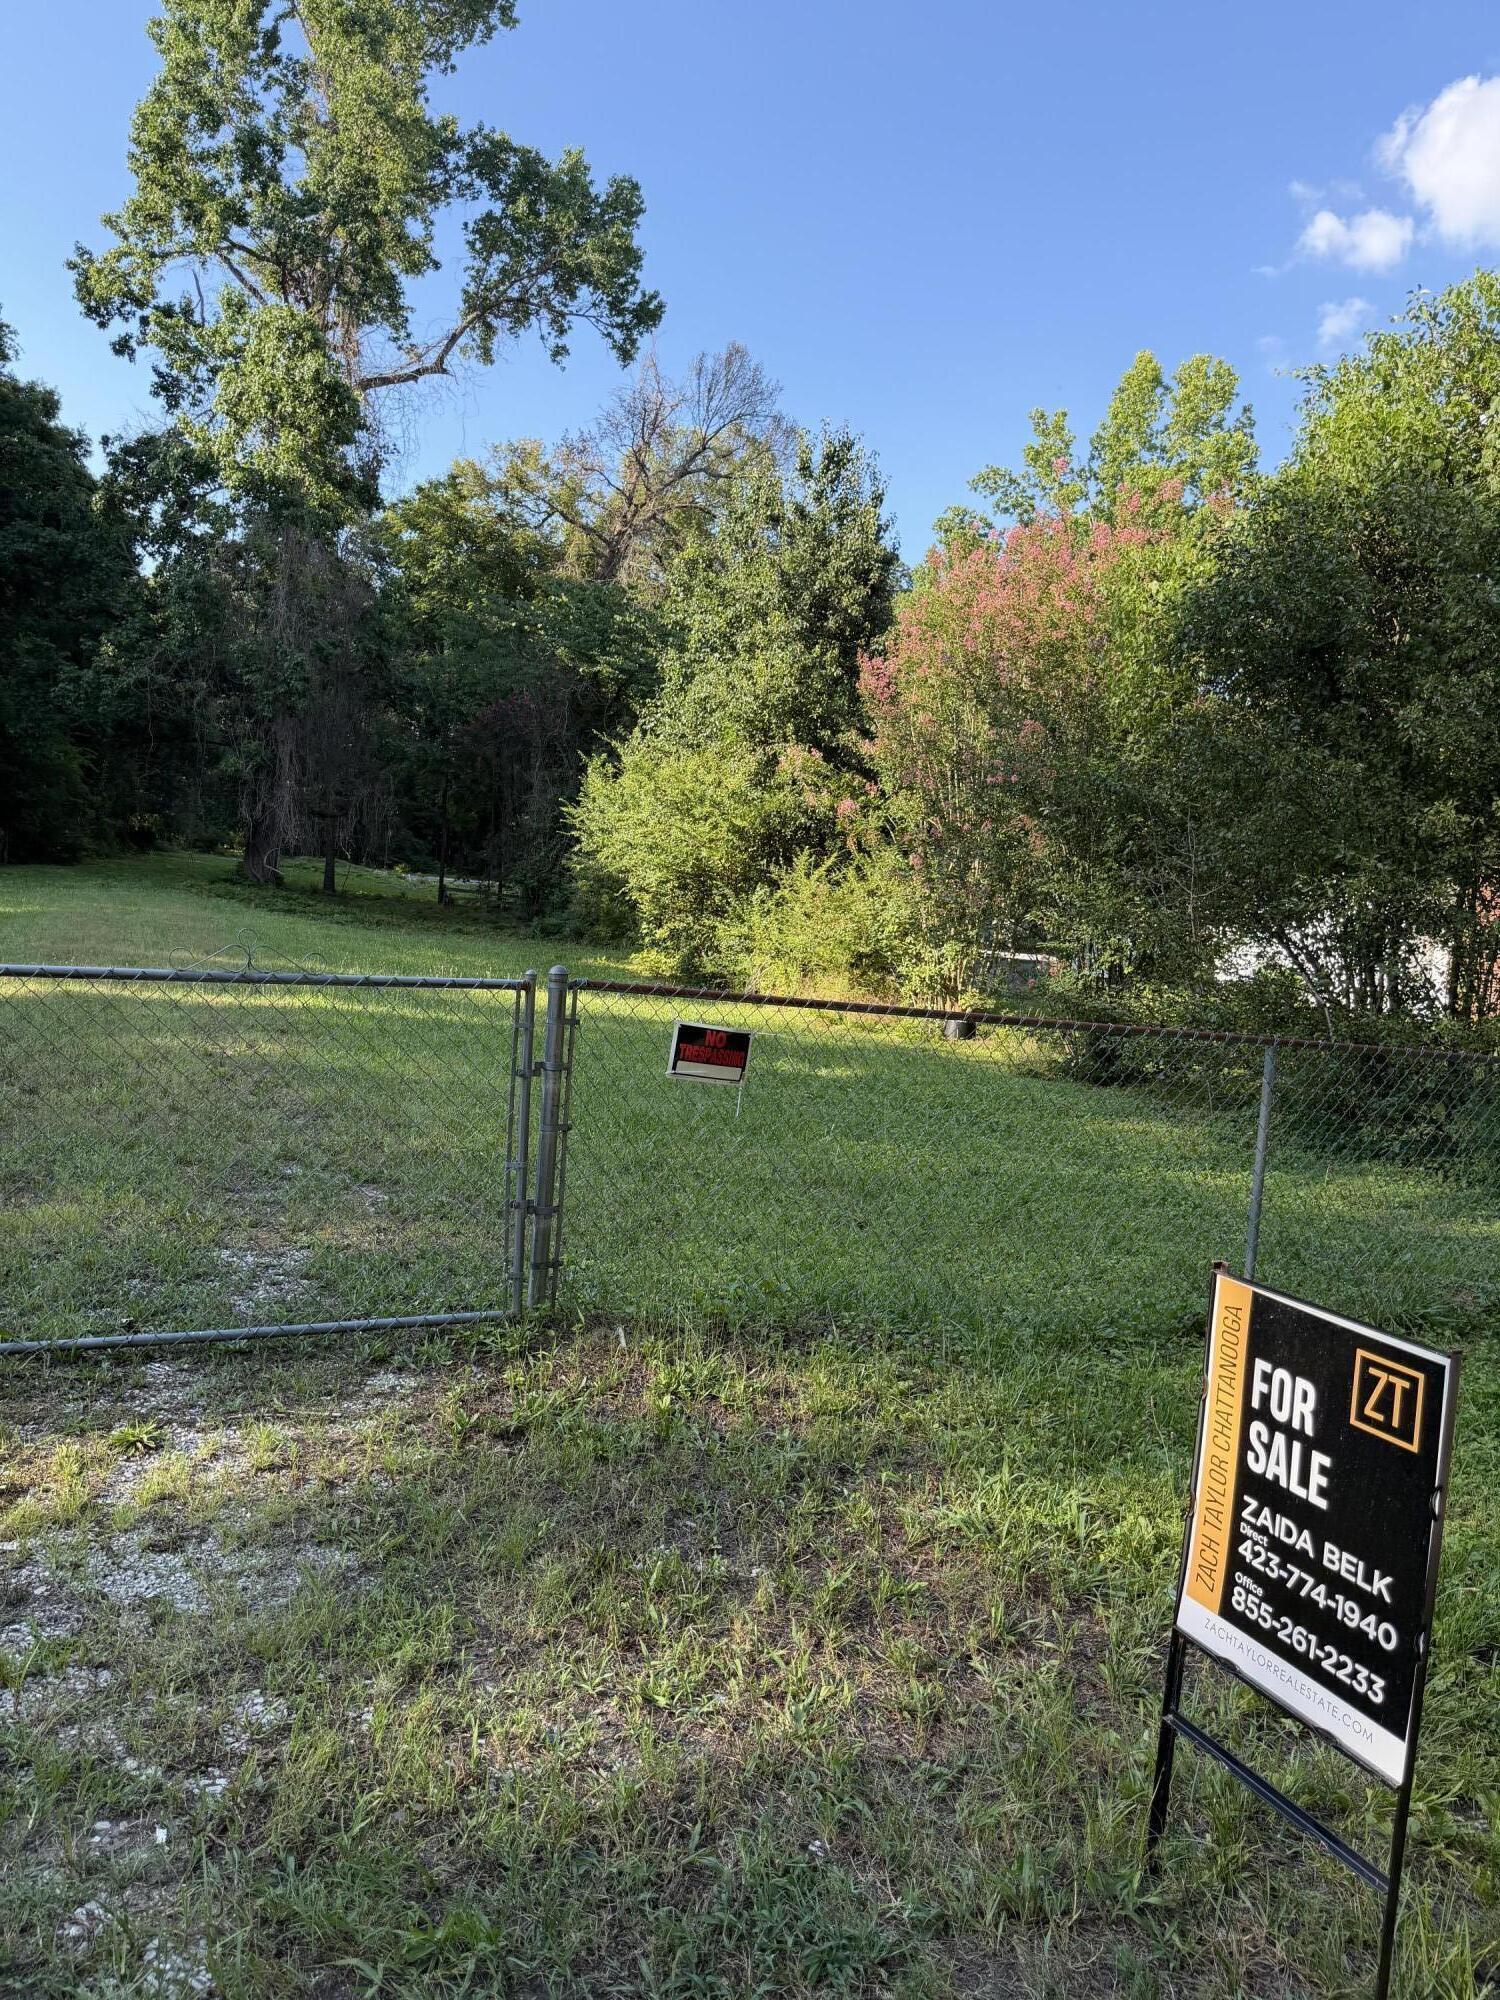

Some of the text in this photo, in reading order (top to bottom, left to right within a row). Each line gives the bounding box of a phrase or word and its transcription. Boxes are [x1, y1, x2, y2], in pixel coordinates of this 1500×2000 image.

[705, 1030, 727, 1048] NO
[1251, 1357, 1317, 1437] FOR
[1363, 1366, 1410, 1429] ZT
[1196, 1305, 1243, 1592] ZACH TAYLOR CHATTANOOGA
[1247, 1420, 1332, 1511] SALE
[1239, 1521, 1269, 1547] Direct
[1241, 1494, 1395, 1604] ZAIDA BELK
[1234, 1571, 1263, 1597] Office
[1237, 1539, 1398, 1651] 423-774-1940
[1204, 1617, 1374, 1744] ZACHTAYLORREALESTATE.COM
[1231, 1586, 1386, 1703] 855-261-2233
